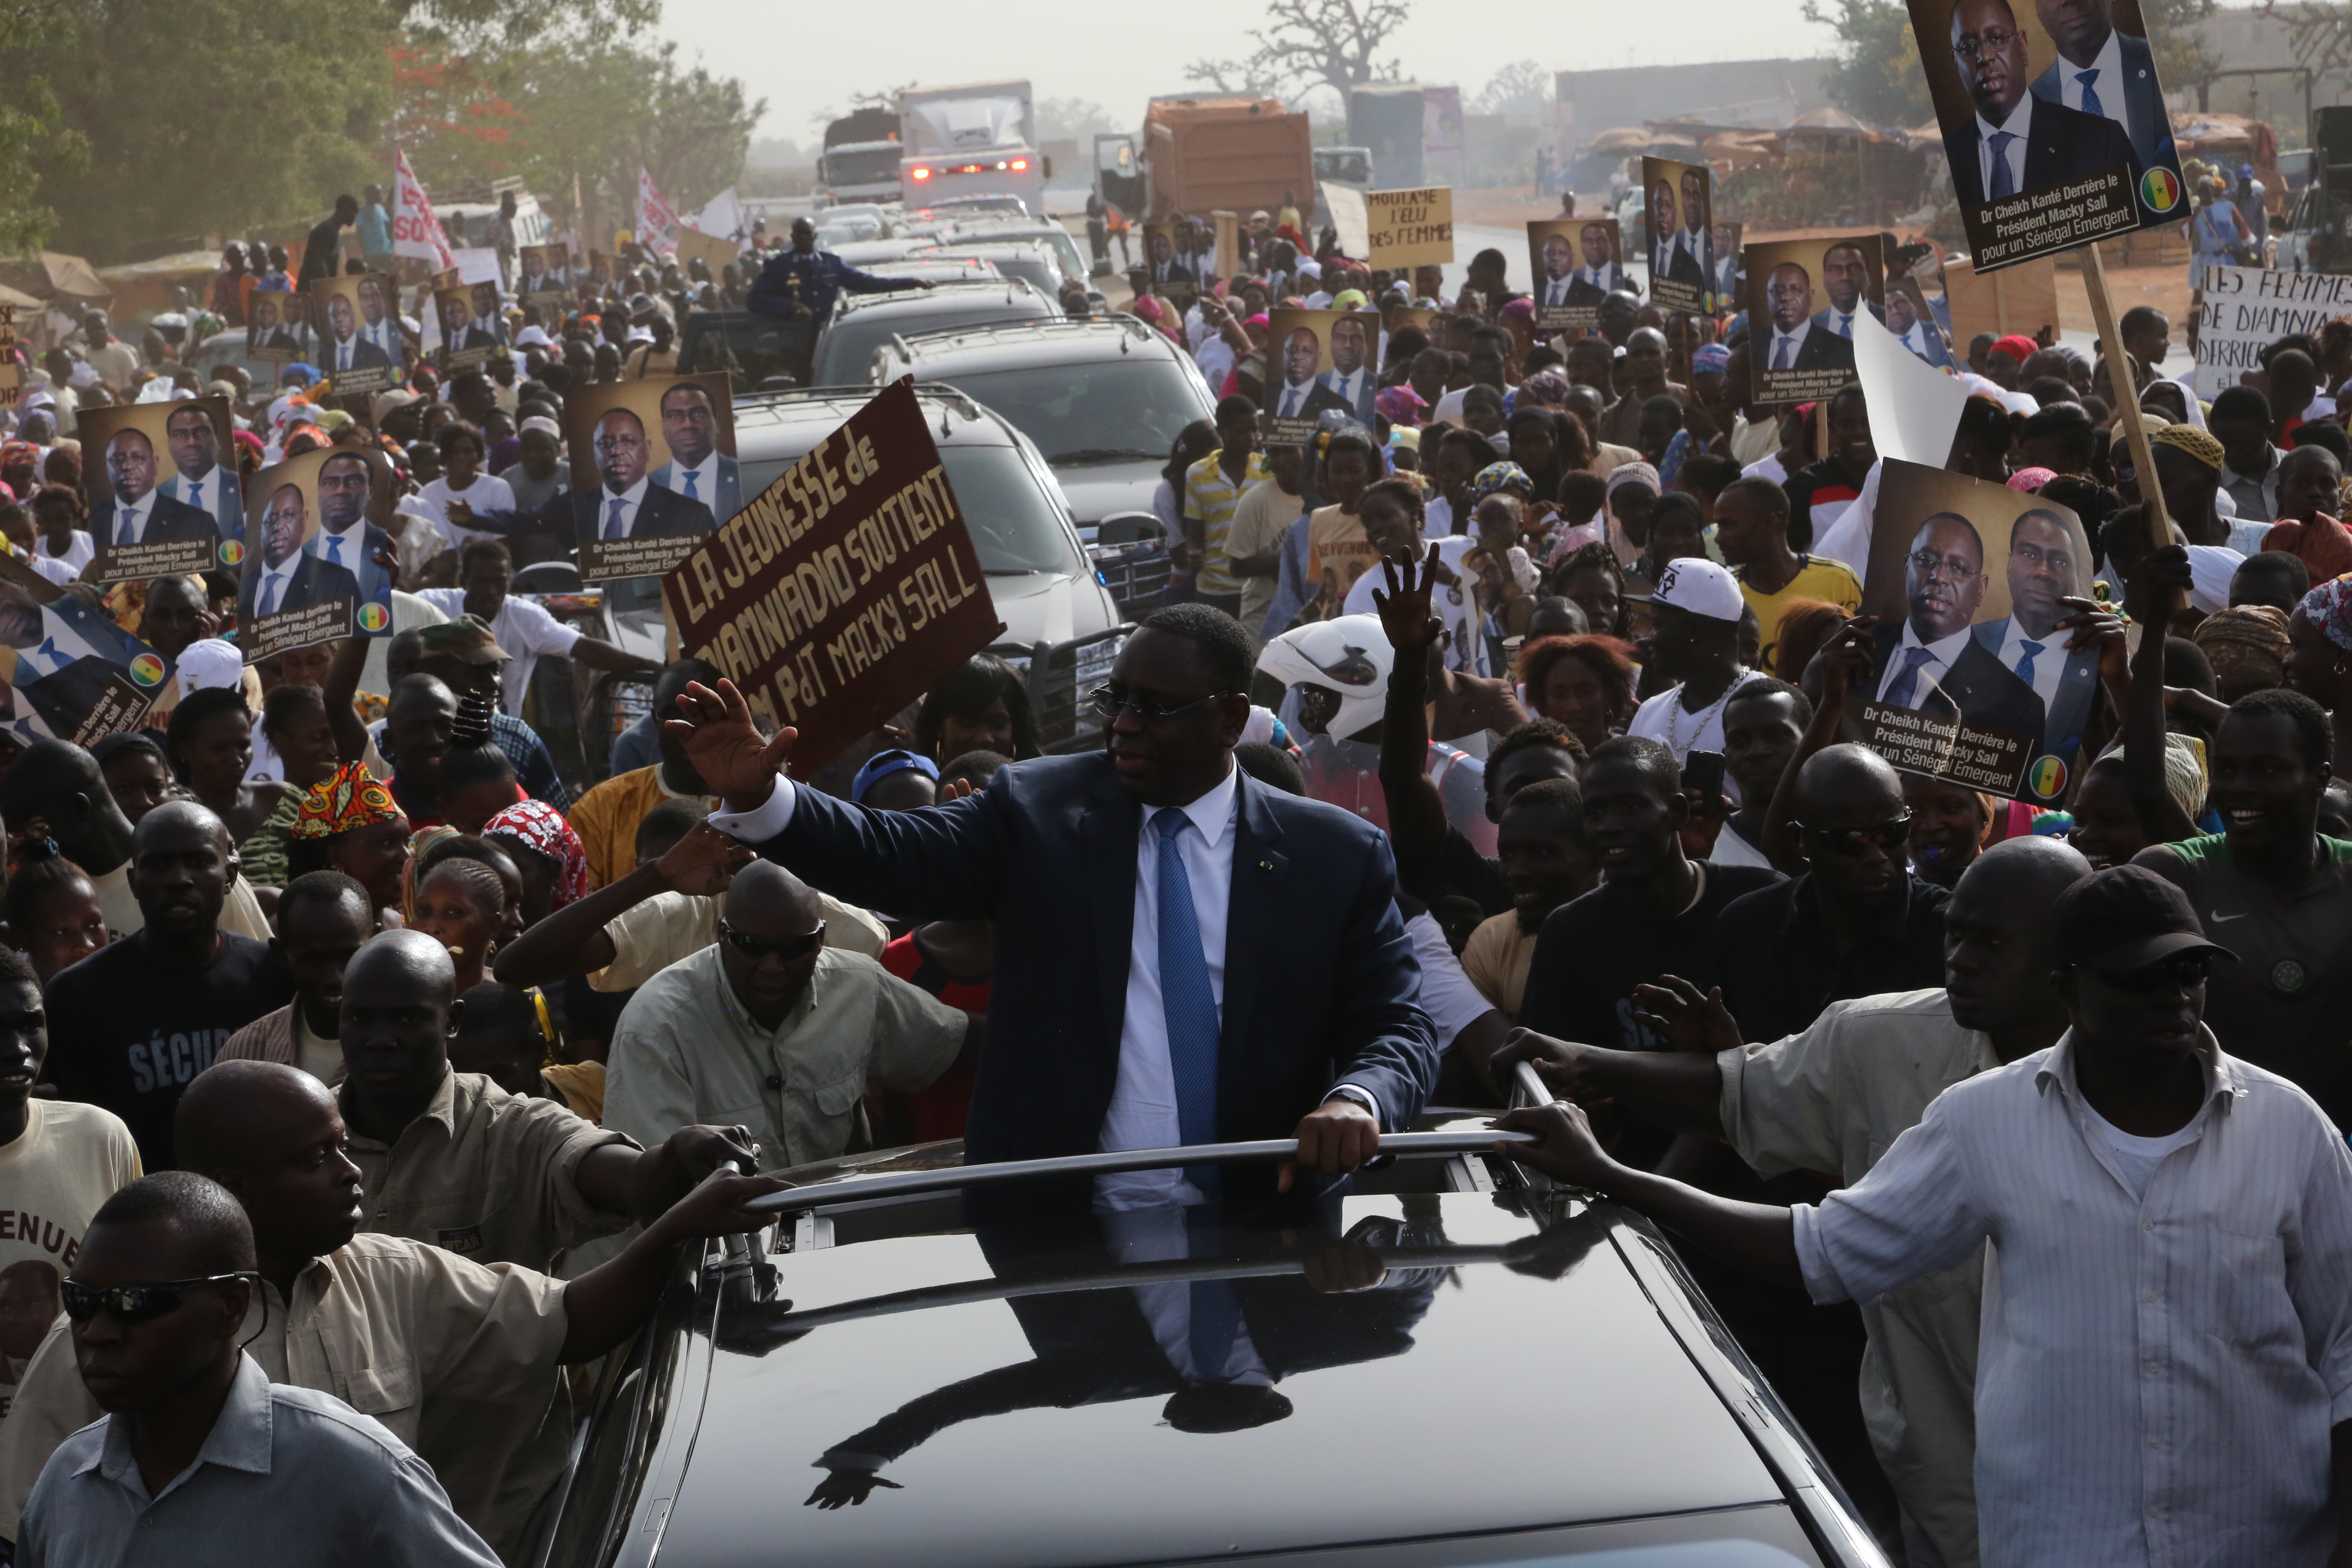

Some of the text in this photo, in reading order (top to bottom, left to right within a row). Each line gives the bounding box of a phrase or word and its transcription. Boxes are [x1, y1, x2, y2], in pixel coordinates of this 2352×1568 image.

[1981, 173, 2119, 224] Dr Cheikh Kanté Derrière le
[1996, 194, 2108, 238] Président Macky Sall
[1982, 206, 2131, 264] pour un Sénégal Emergent
[2206, 266, 2243, 294] LES
[2201, 301, 2225, 329] DE
[677, 548, 725, 624] LA
[718, 439, 847, 588] JEUNESSE
[844, 465, 955, 586] SOUTIENT
[826, 594, 906, 686] MACKY
[898, 545, 978, 631] SALL
[105, 703, 122, 723] Sall
[1864, 707, 2018, 753] Dr Cheikh Kanté Derrière le
[1874, 727, 1999, 766] Président Macky Sall
[1883, 749, 1900, 761] un
[1902, 751, 1954, 774] Sénégal
[1954, 761, 2012, 787] Emergent
